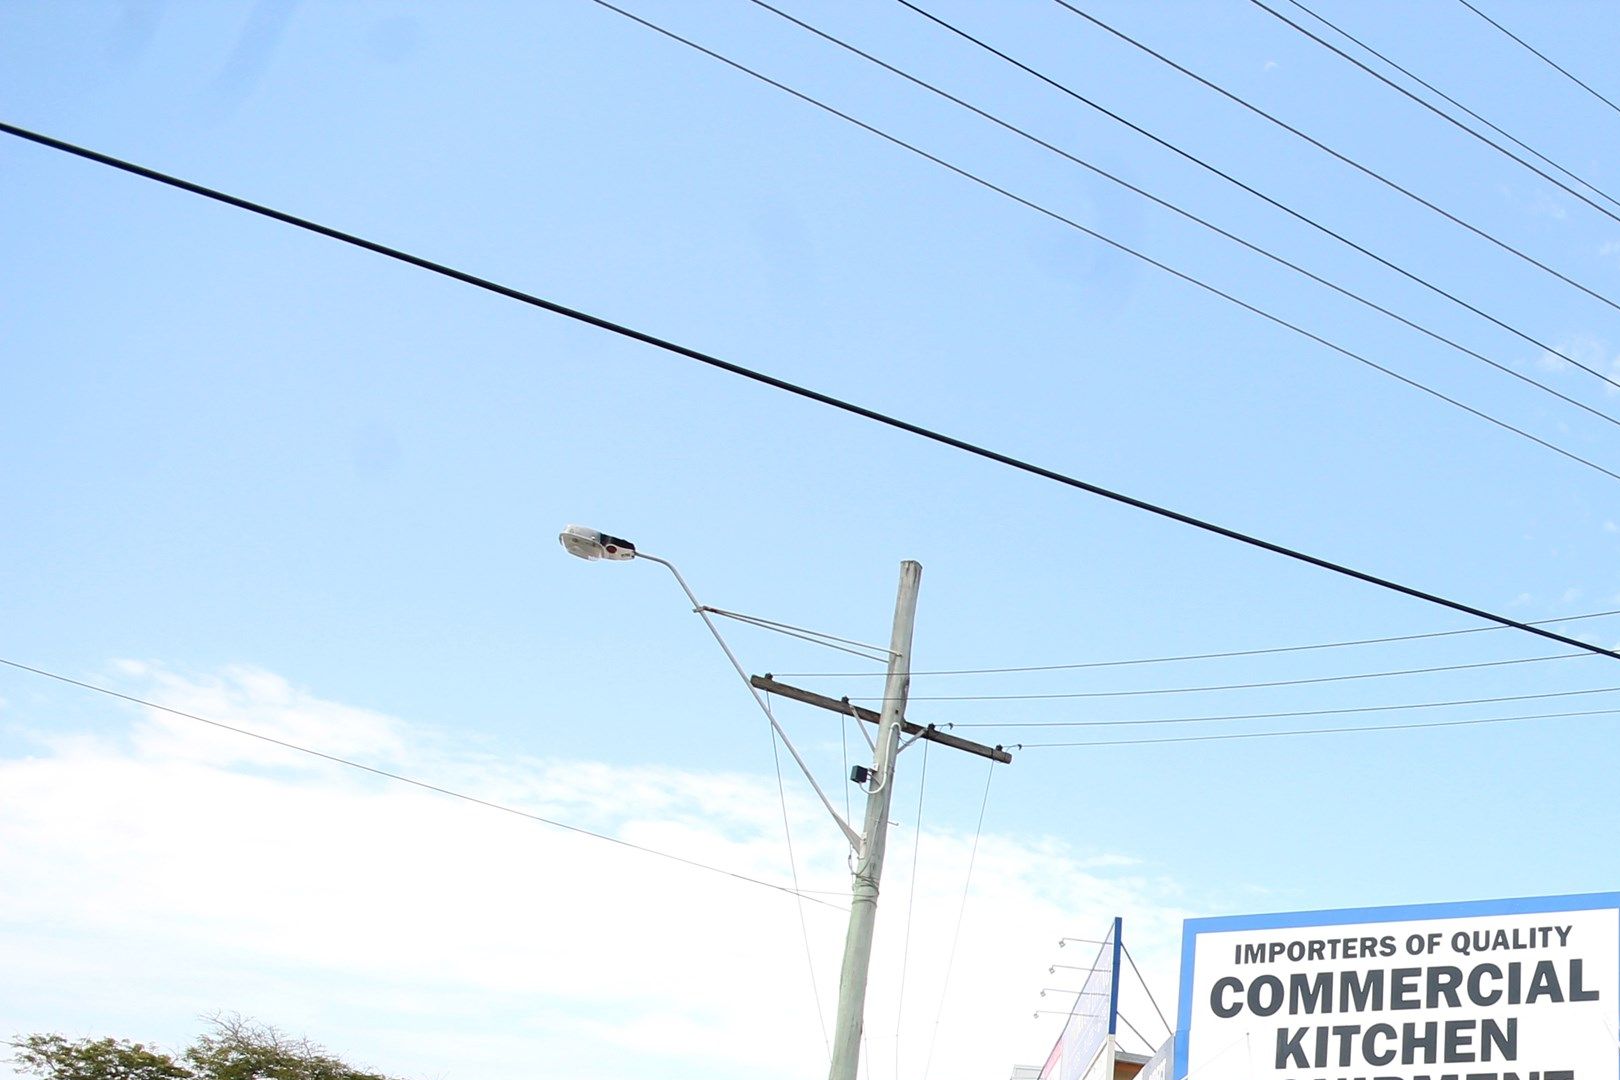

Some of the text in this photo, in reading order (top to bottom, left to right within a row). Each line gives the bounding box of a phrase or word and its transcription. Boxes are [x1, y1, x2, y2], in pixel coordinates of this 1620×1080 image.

[1235, 925, 1573, 965] IMPORTERS OF QUALITY
[1209, 958, 1600, 1019] COMMERCIAL
[1275, 1018, 1518, 1070] KITCHEN
